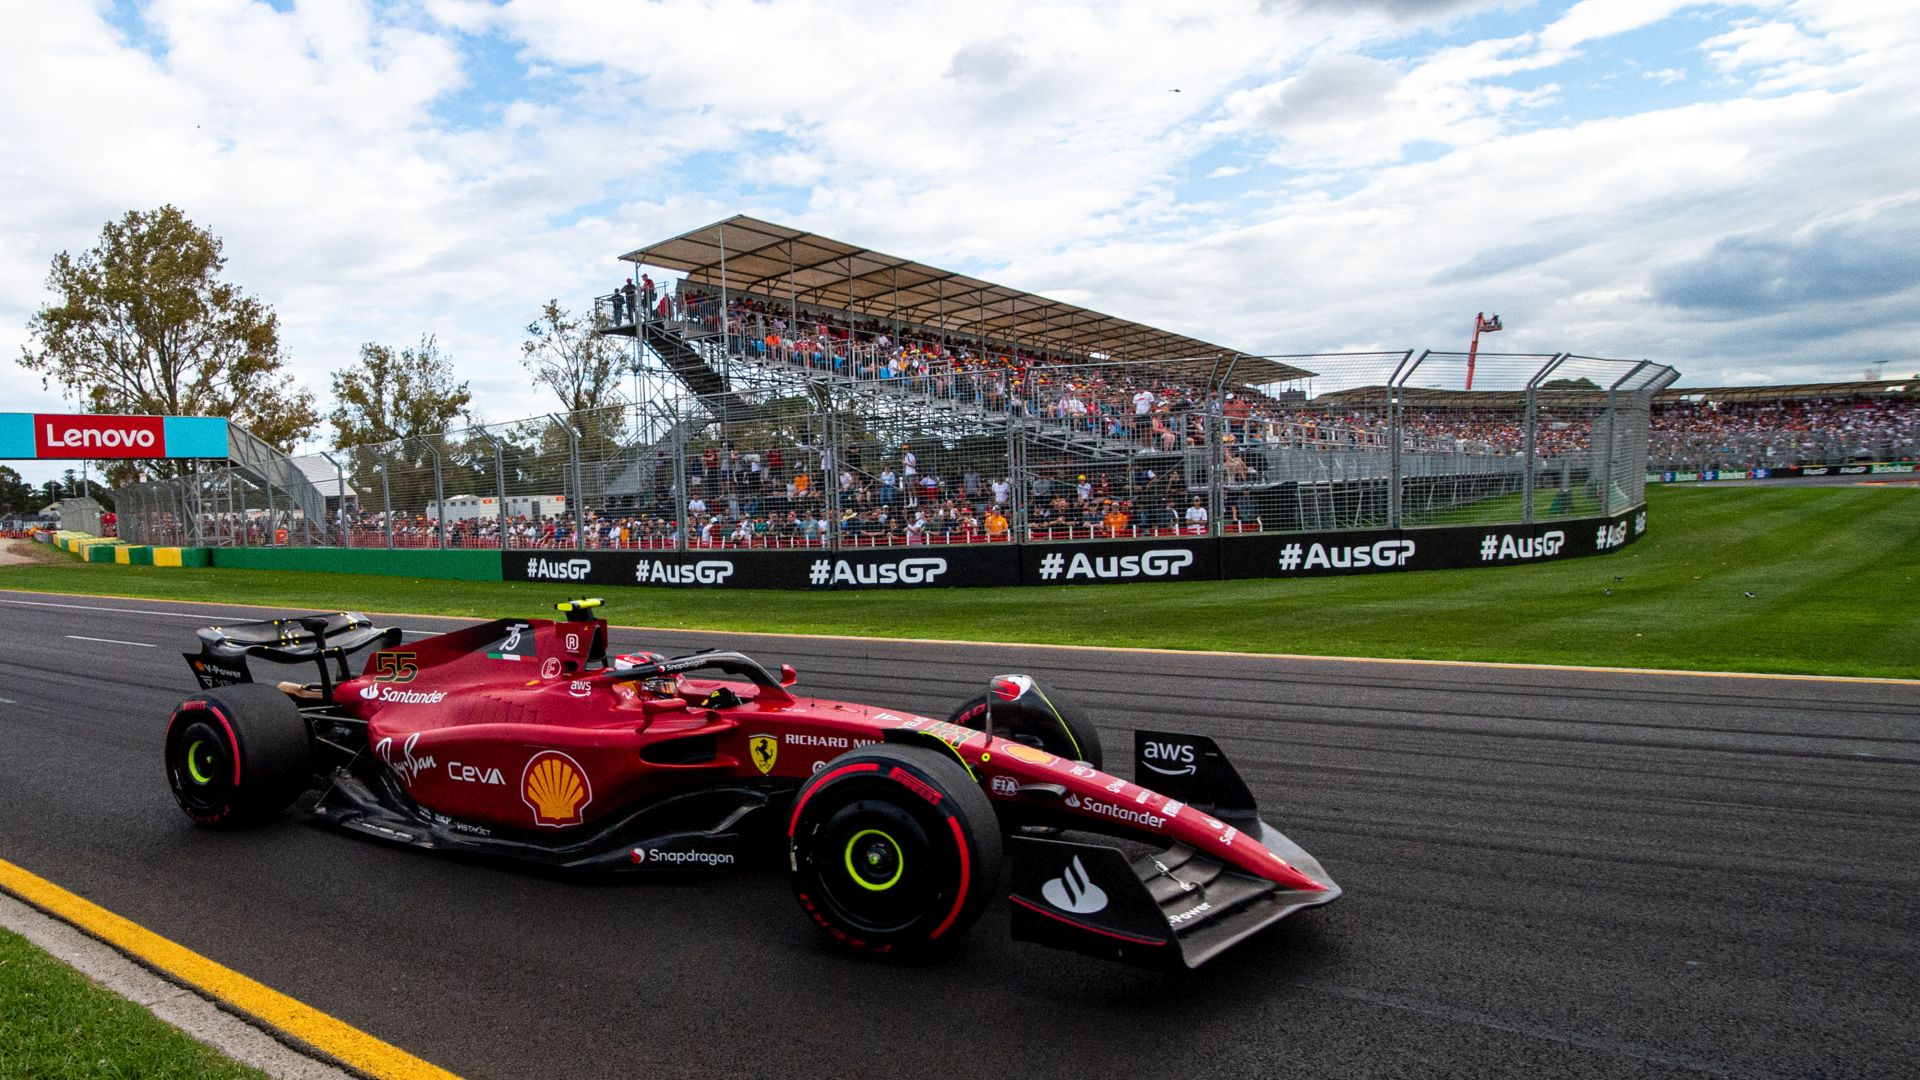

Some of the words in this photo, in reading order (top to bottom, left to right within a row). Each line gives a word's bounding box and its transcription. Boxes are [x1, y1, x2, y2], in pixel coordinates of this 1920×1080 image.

[46, 423, 155, 447] Lenovo
[1278, 540, 1416, 571] #AusGP
[1481, 530, 1566, 560] #AusGP
[527, 557, 592, 581] #AusGP
[635, 559, 734, 584] #AusGP
[809, 557, 947, 585] #AusGP
[1038, 549, 1194, 580] #AusGP
[204, 663, 241, 678] V-Power
[374, 652, 419, 684] 55
[666, 660, 707, 671] Snapdragon
[379, 687, 448, 704] Santander
[570, 681, 592, 691] aws
[785, 733, 848, 748] RICHARD
[1143, 741, 1195, 763] aws
[375, 732, 437, 787] Ray-Ban
[991, 778, 1017, 793] FIA
[1083, 797, 1167, 828] Santander
[649, 848, 735, 866] Snapdragon
[1168, 902, 1211, 926] -Power
